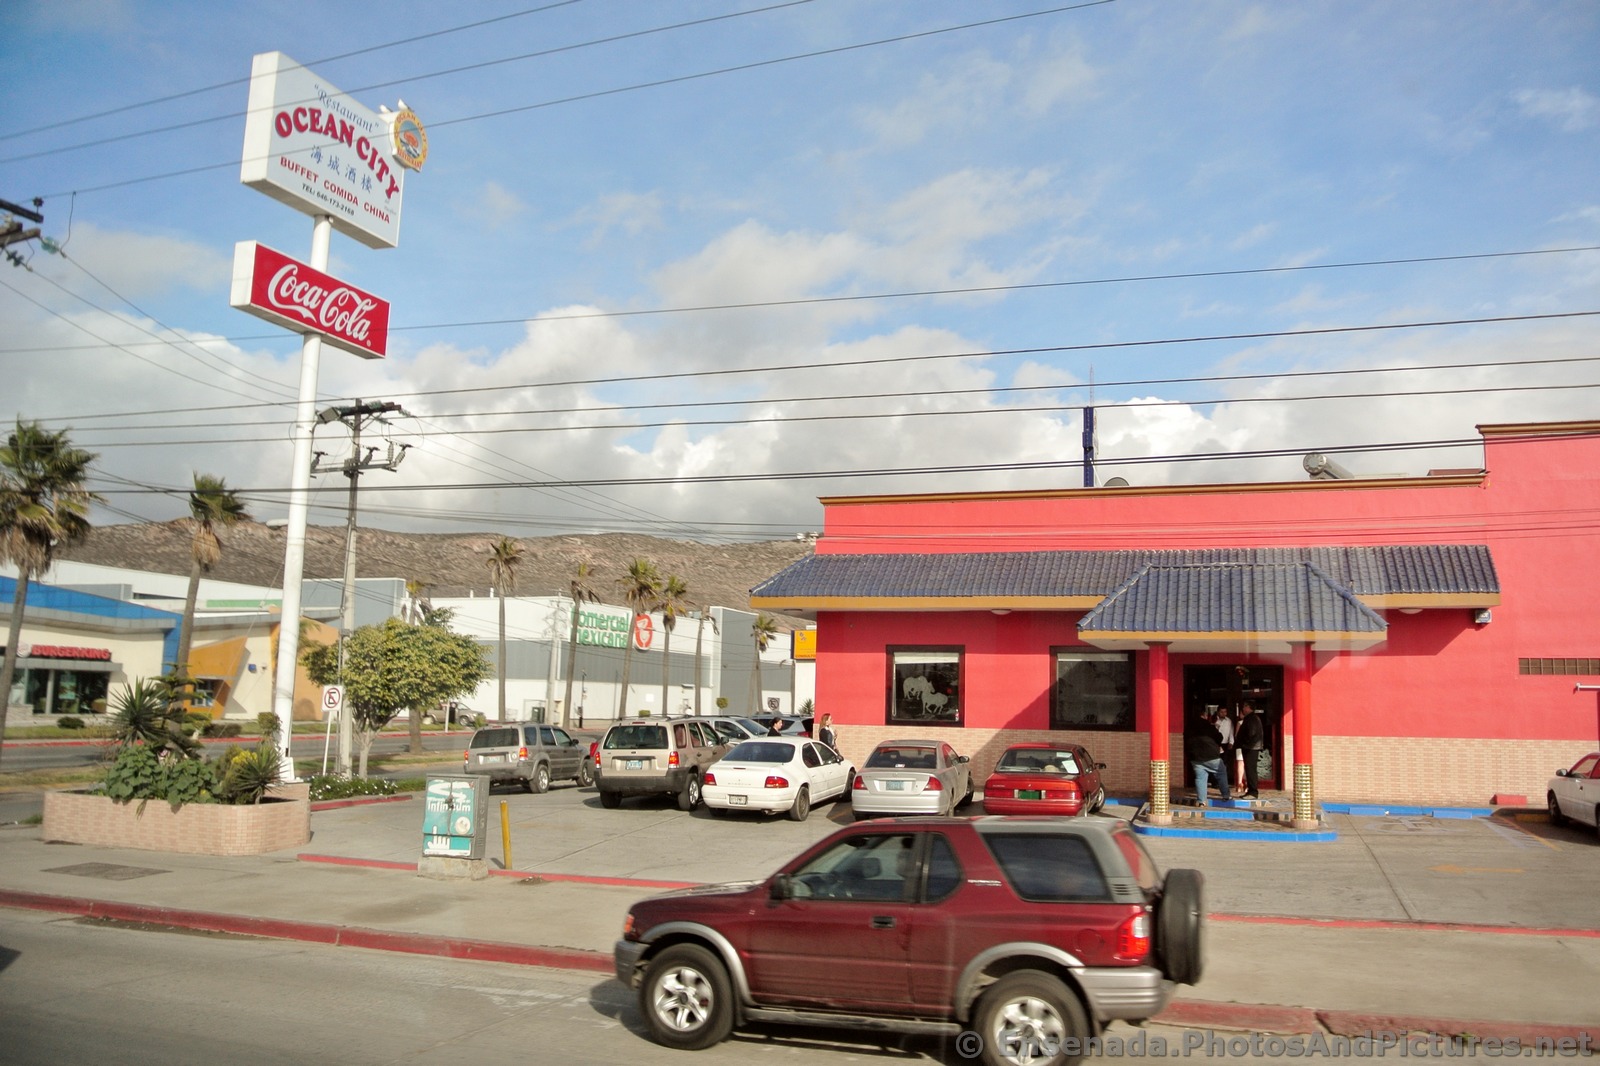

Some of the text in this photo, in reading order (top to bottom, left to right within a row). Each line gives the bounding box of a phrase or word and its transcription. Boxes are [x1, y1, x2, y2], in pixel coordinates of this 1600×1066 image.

[275, 106, 400, 200] OCEAN CITY
[280, 156, 390, 224] BUFFET COMIDA CHINA
[267, 263, 378, 343] Coca-Cola
[31, 644, 110, 660] BURGER KING
